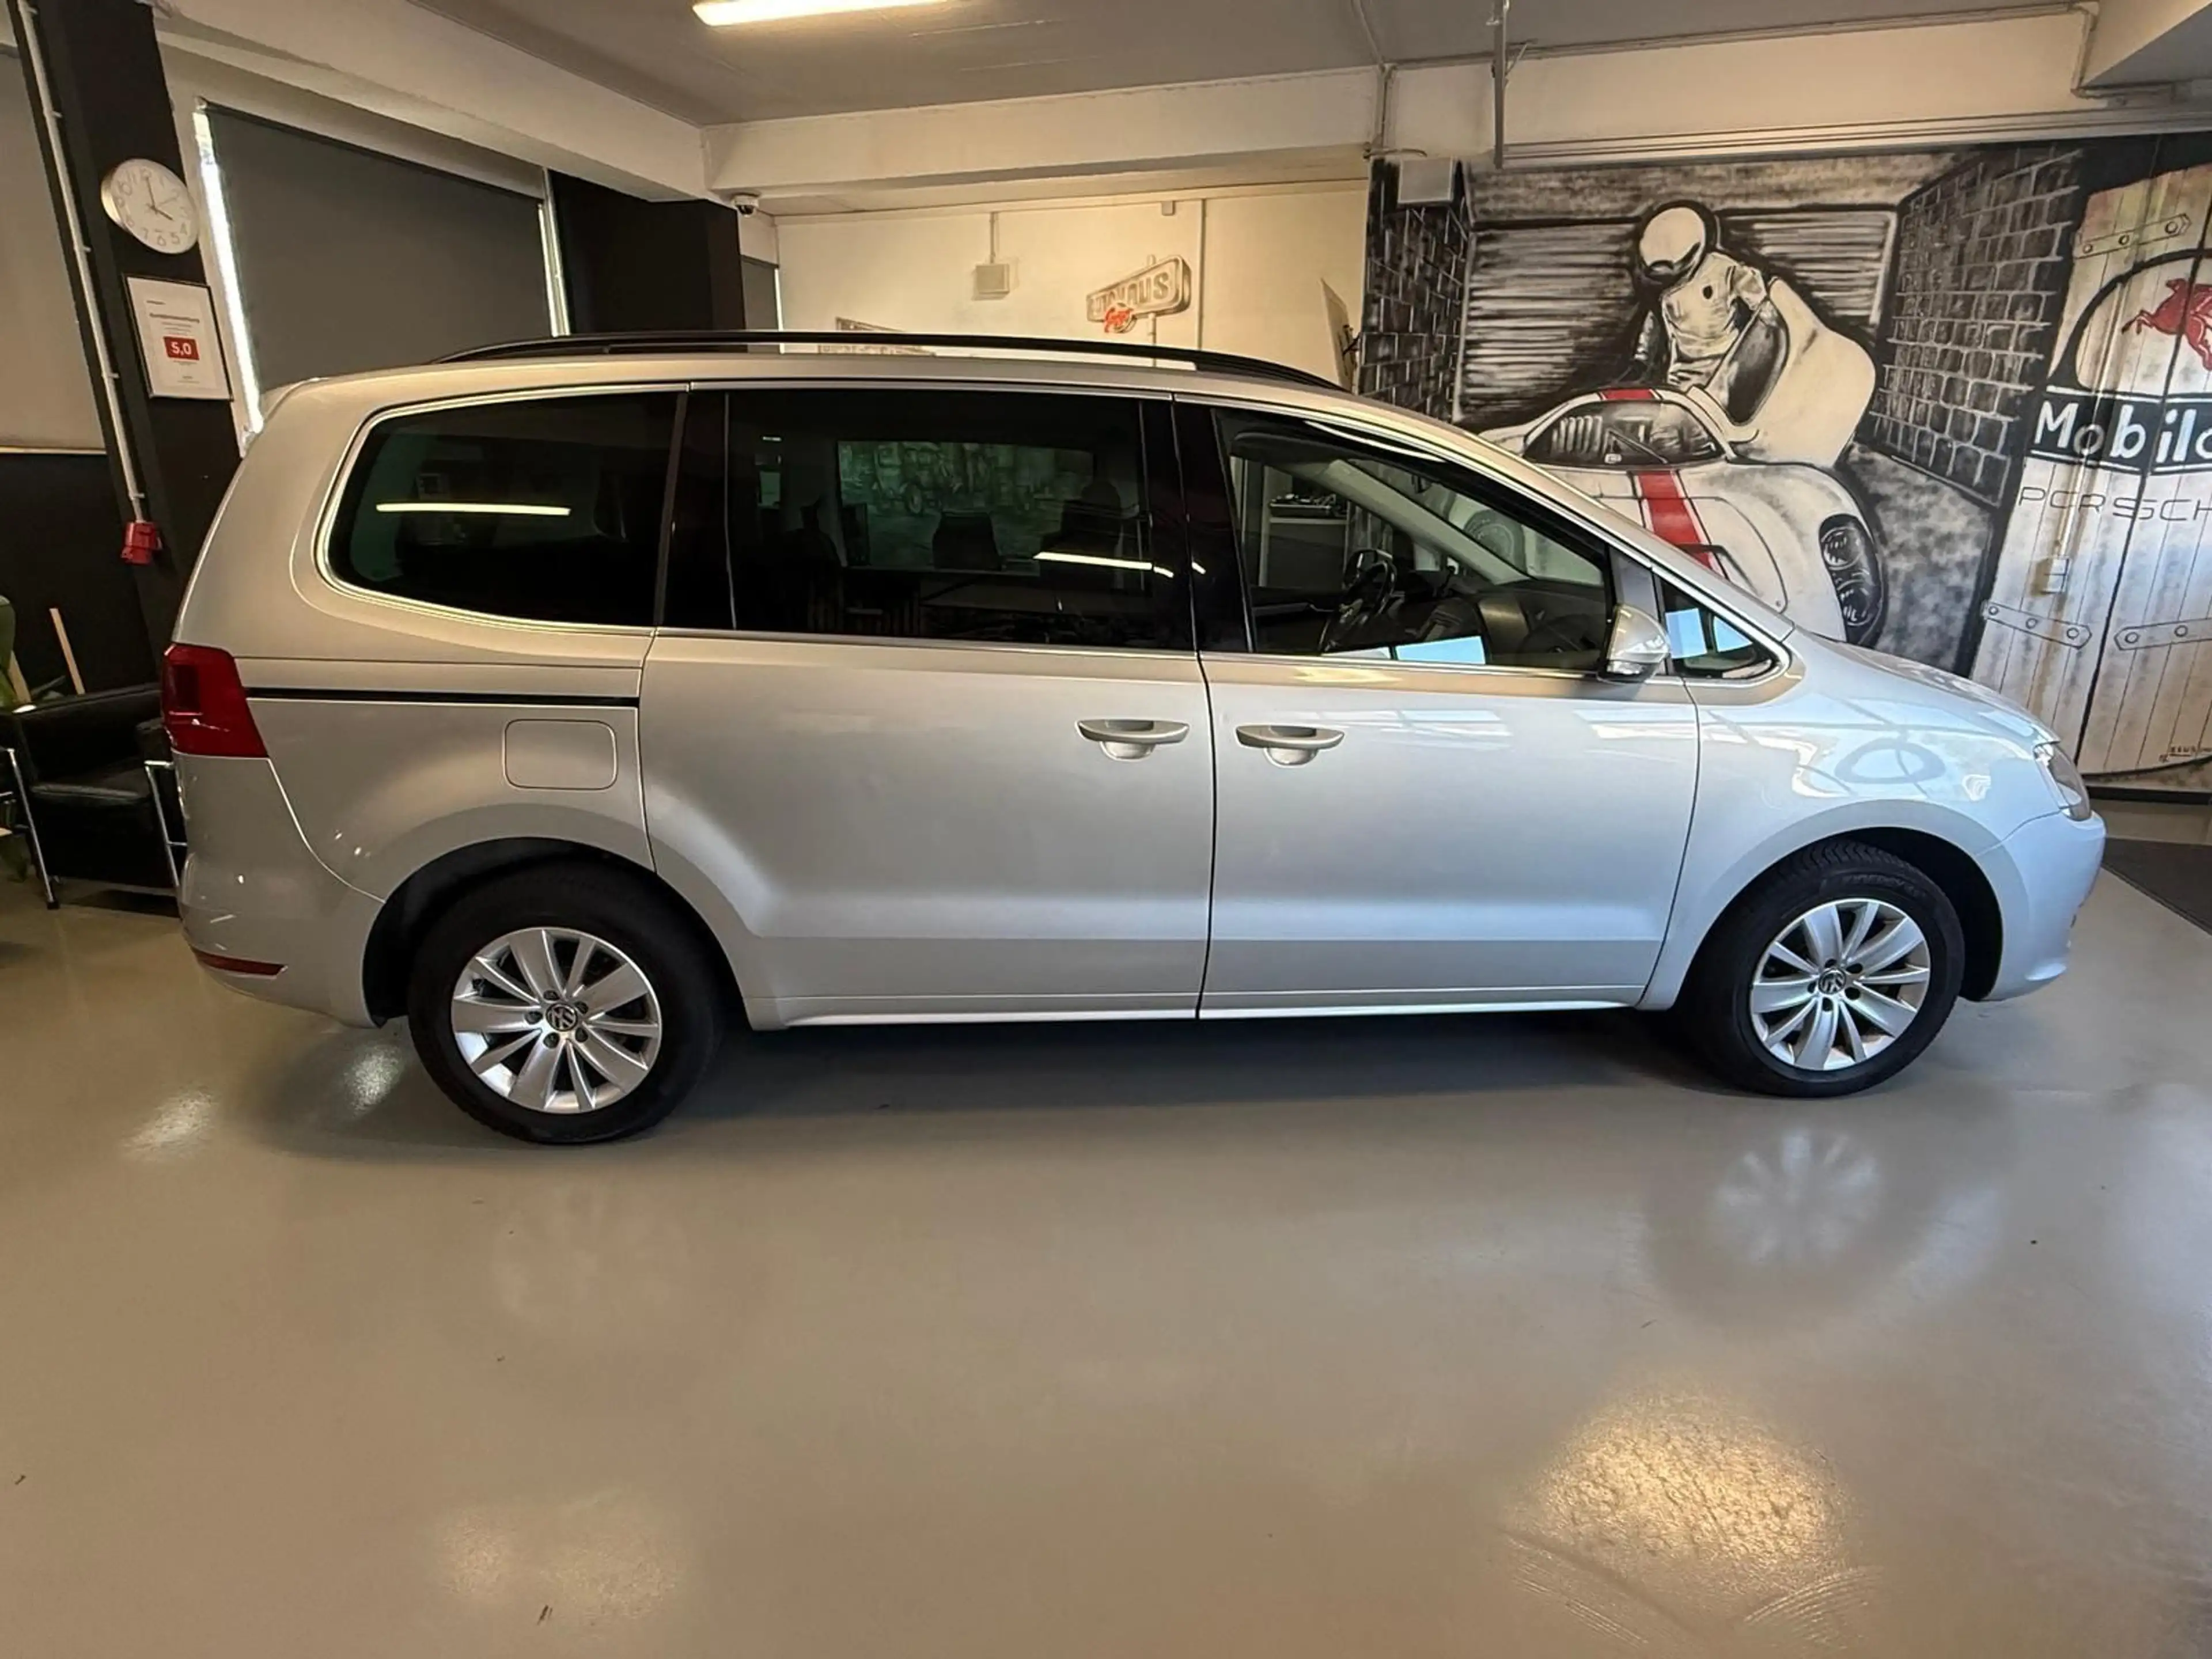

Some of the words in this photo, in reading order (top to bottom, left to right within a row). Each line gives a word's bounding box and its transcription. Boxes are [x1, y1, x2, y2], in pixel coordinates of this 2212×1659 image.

[140, 226, 149, 240] 7
[179, 222, 188, 236] 4
[156, 234, 167, 247] 6
[169, 232, 180, 244] 5
[171, 341, 192, 355] 5,0
